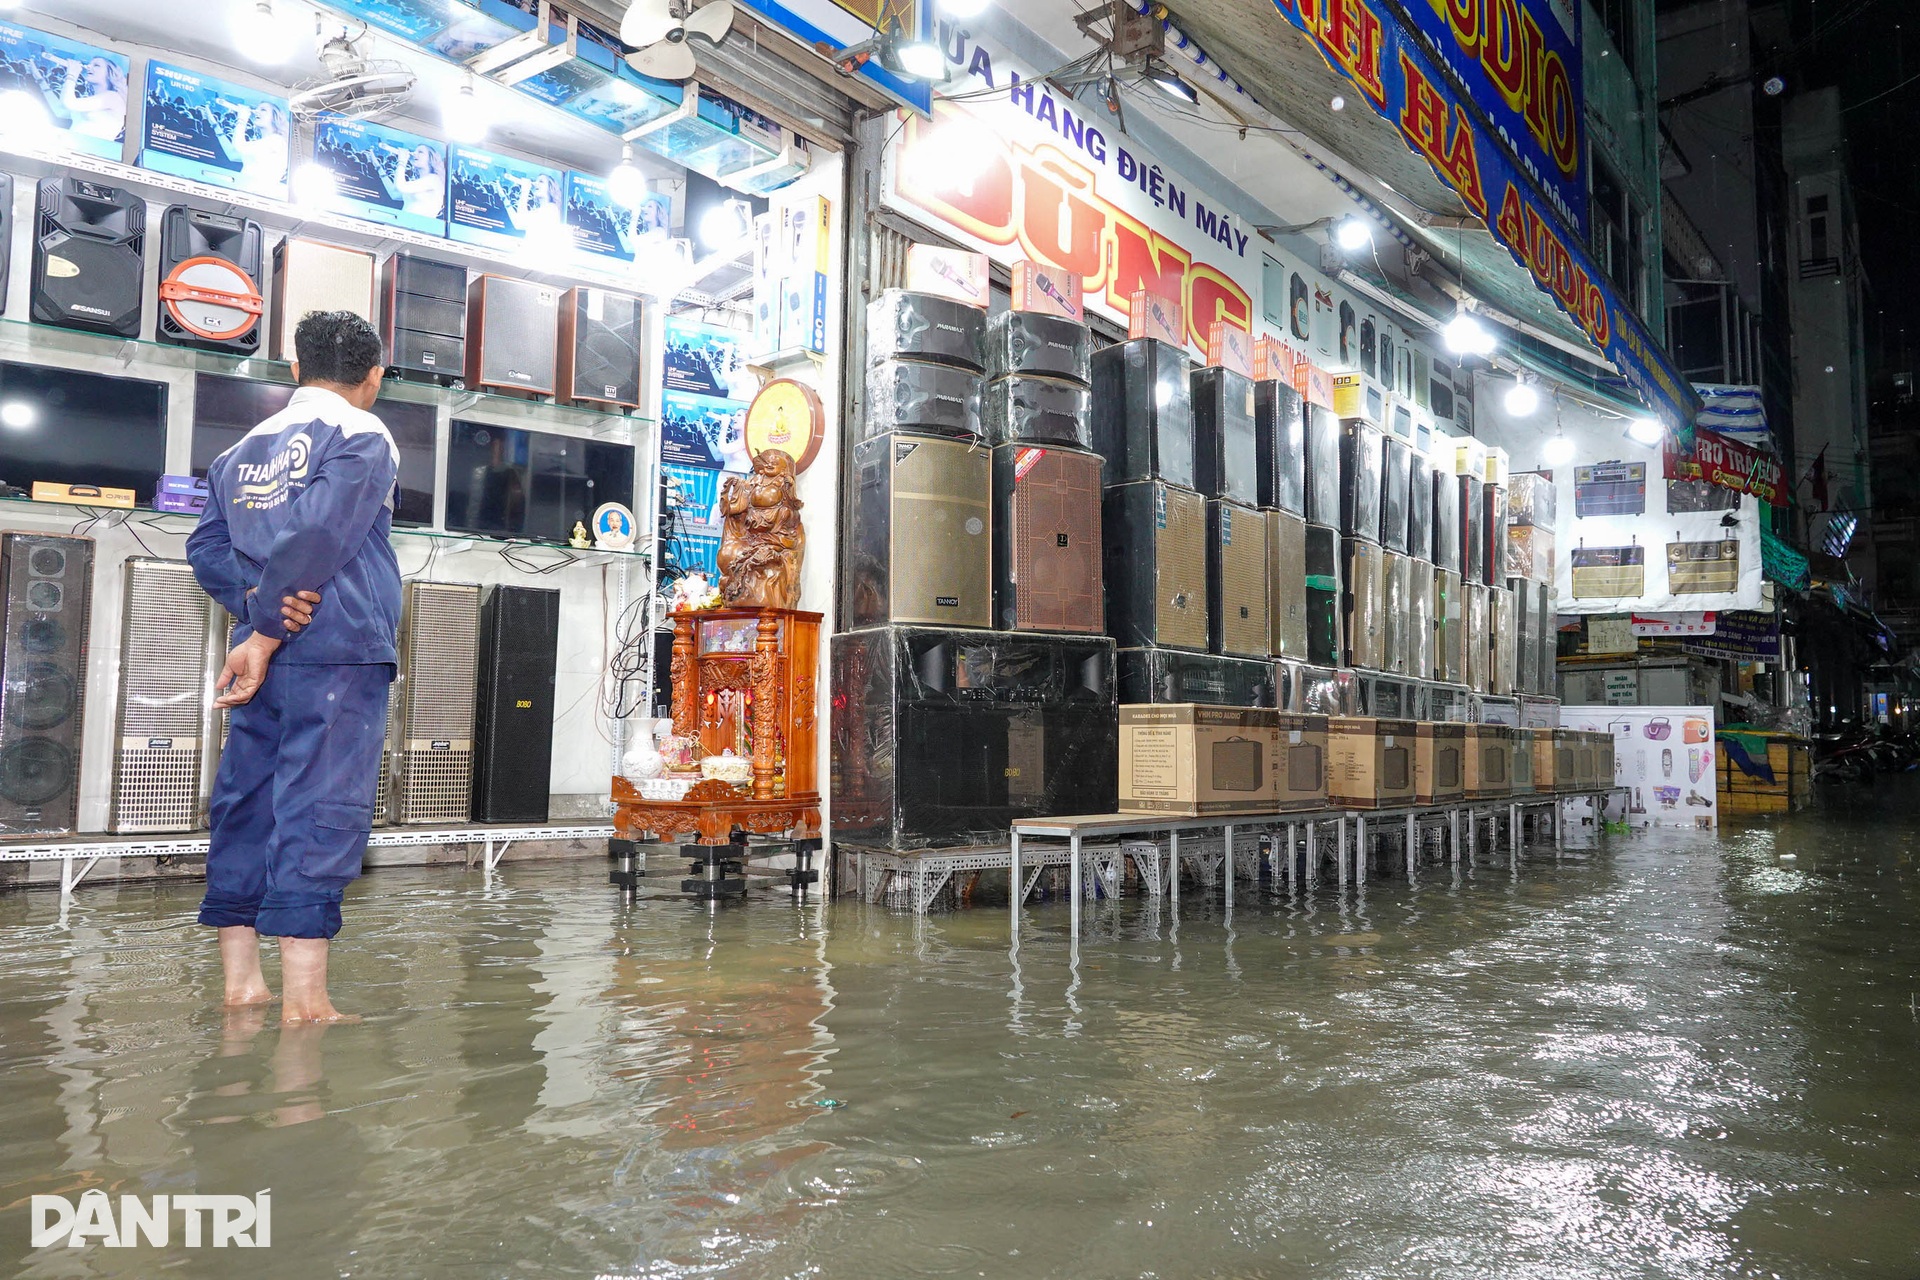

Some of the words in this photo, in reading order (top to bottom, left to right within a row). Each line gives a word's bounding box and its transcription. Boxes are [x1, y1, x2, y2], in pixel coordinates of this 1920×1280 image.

[155, 66, 200, 86] SHURE
[170, 80, 195, 93] UR18D
[152, 122, 165, 131] UHF
[151, 129, 177, 141] SYSTEM
[339, 127, 360, 138] UR18D
[1399, 47, 1488, 220] HÀ
[457, 149, 492, 164] SHURE
[1010, 70, 1107, 166] HÀNG
[1116, 145, 1187, 219] ĐIỆN
[1195, 200, 1250, 258] MÁY
[455, 205, 475, 214] SYSTEM
[897, 104, 1253, 358] DŨNG
[1496, 180, 1610, 348] AUDIO
[81, 306, 111, 317] SANSUI
[936, 323, 962, 334] PARAMAX
[1047, 341, 1073, 352] PARAMAX
[935, 394, 962, 404] PARAMAX
[105, 493, 131, 501] ORIS
[937, 598, 958, 606] TANNOY
[1212, 711, 1223, 719] PRO
[1224, 711, 1241, 720] AUDIO
